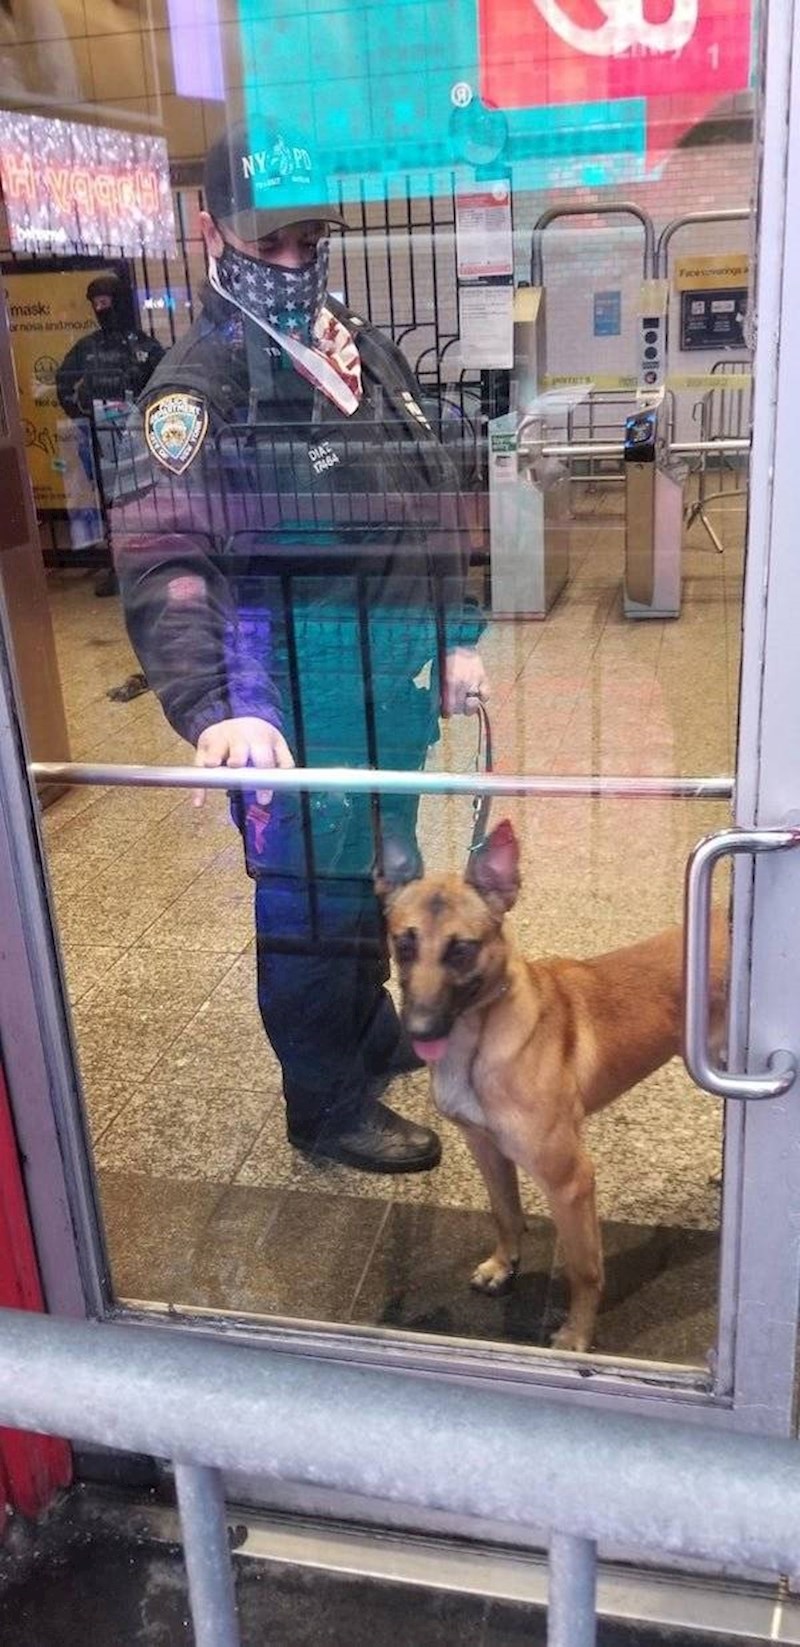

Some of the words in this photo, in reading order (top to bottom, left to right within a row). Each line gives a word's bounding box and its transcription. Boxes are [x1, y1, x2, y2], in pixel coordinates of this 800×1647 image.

[707, 43, 720, 71] 1
[241, 151, 267, 179] NY
[292, 148, 312, 171] PD
[10, 302, 51, 317] mask:
